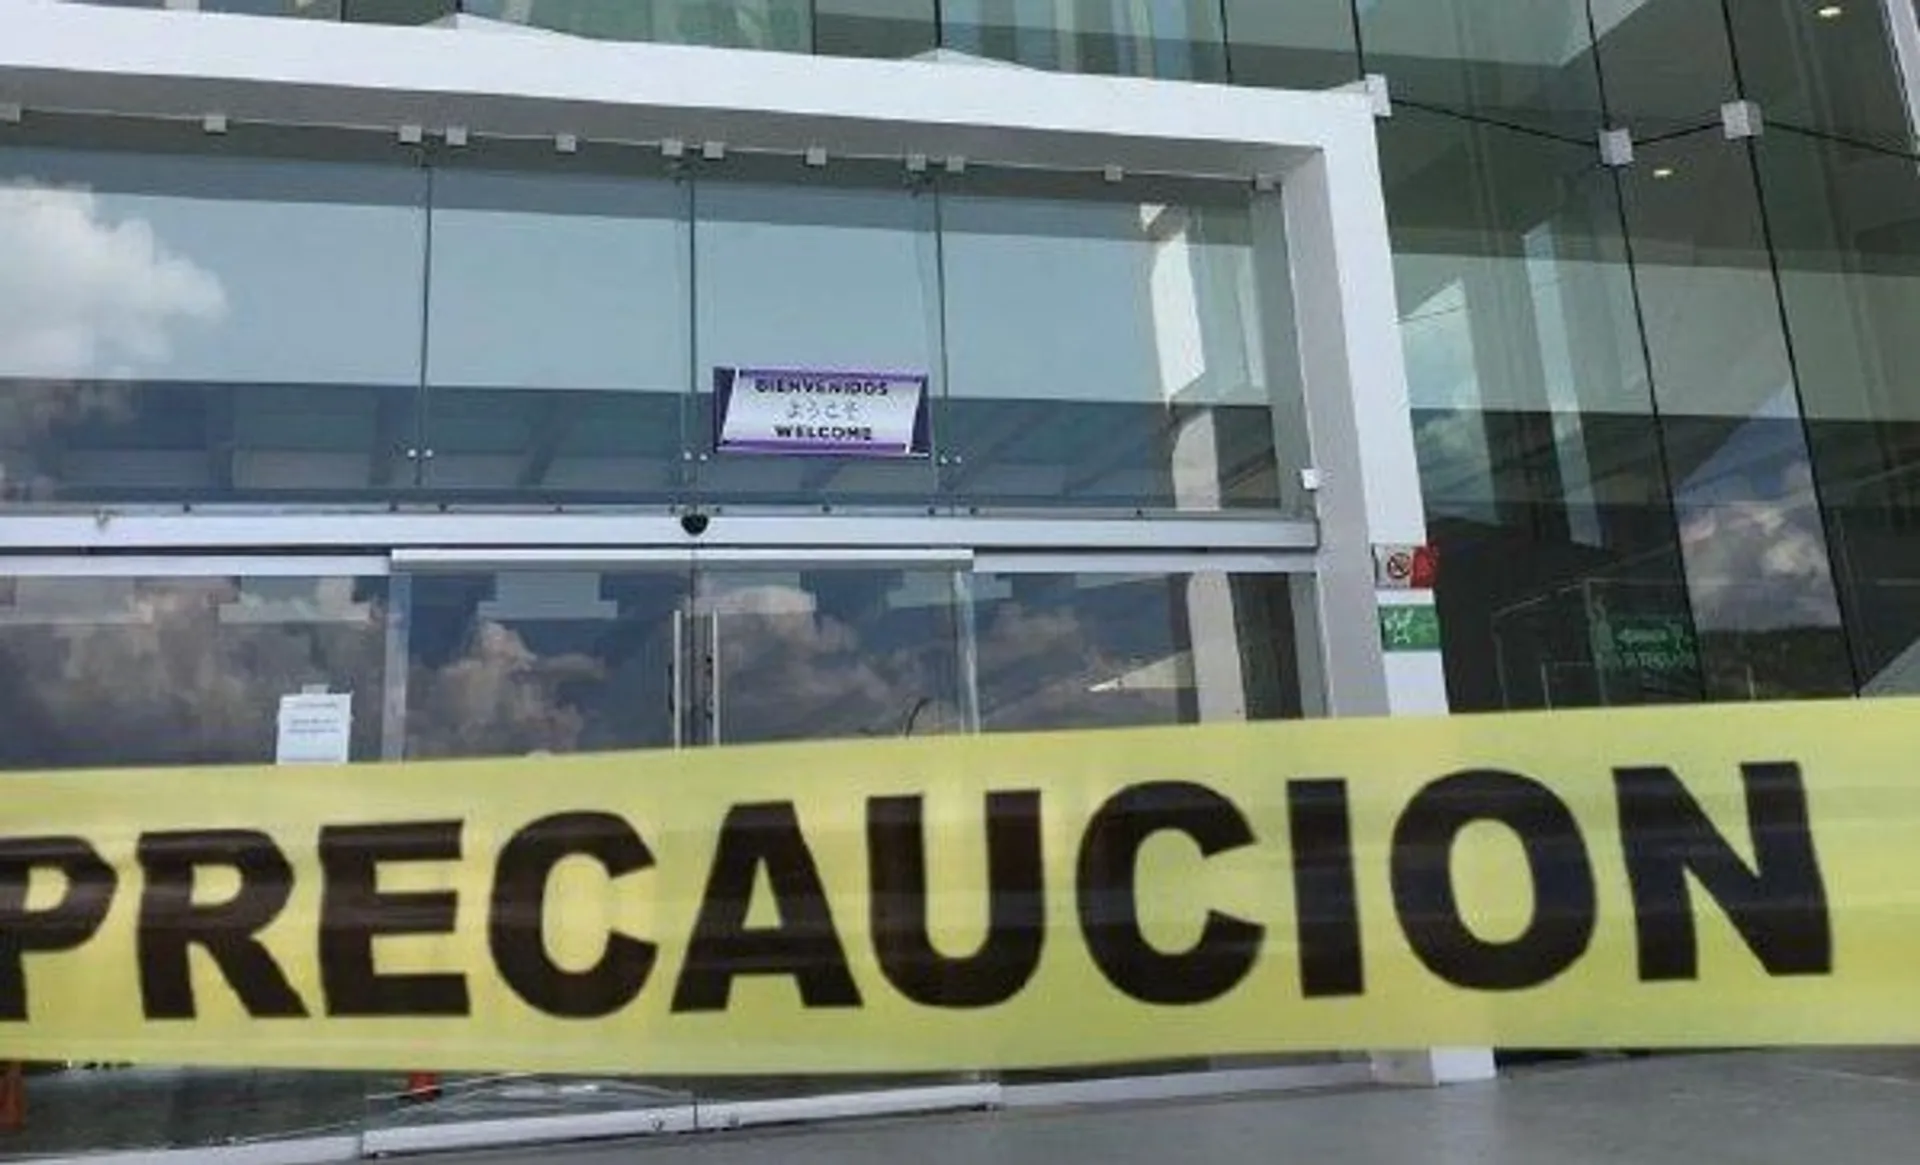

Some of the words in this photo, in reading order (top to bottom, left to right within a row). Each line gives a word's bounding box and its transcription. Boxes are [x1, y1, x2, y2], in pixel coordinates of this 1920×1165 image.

[754, 377, 889, 396] BIENVENIDOS
[773, 425, 873, 441] WELCOME
[0, 760, 1833, 1020] PRECAUCION
